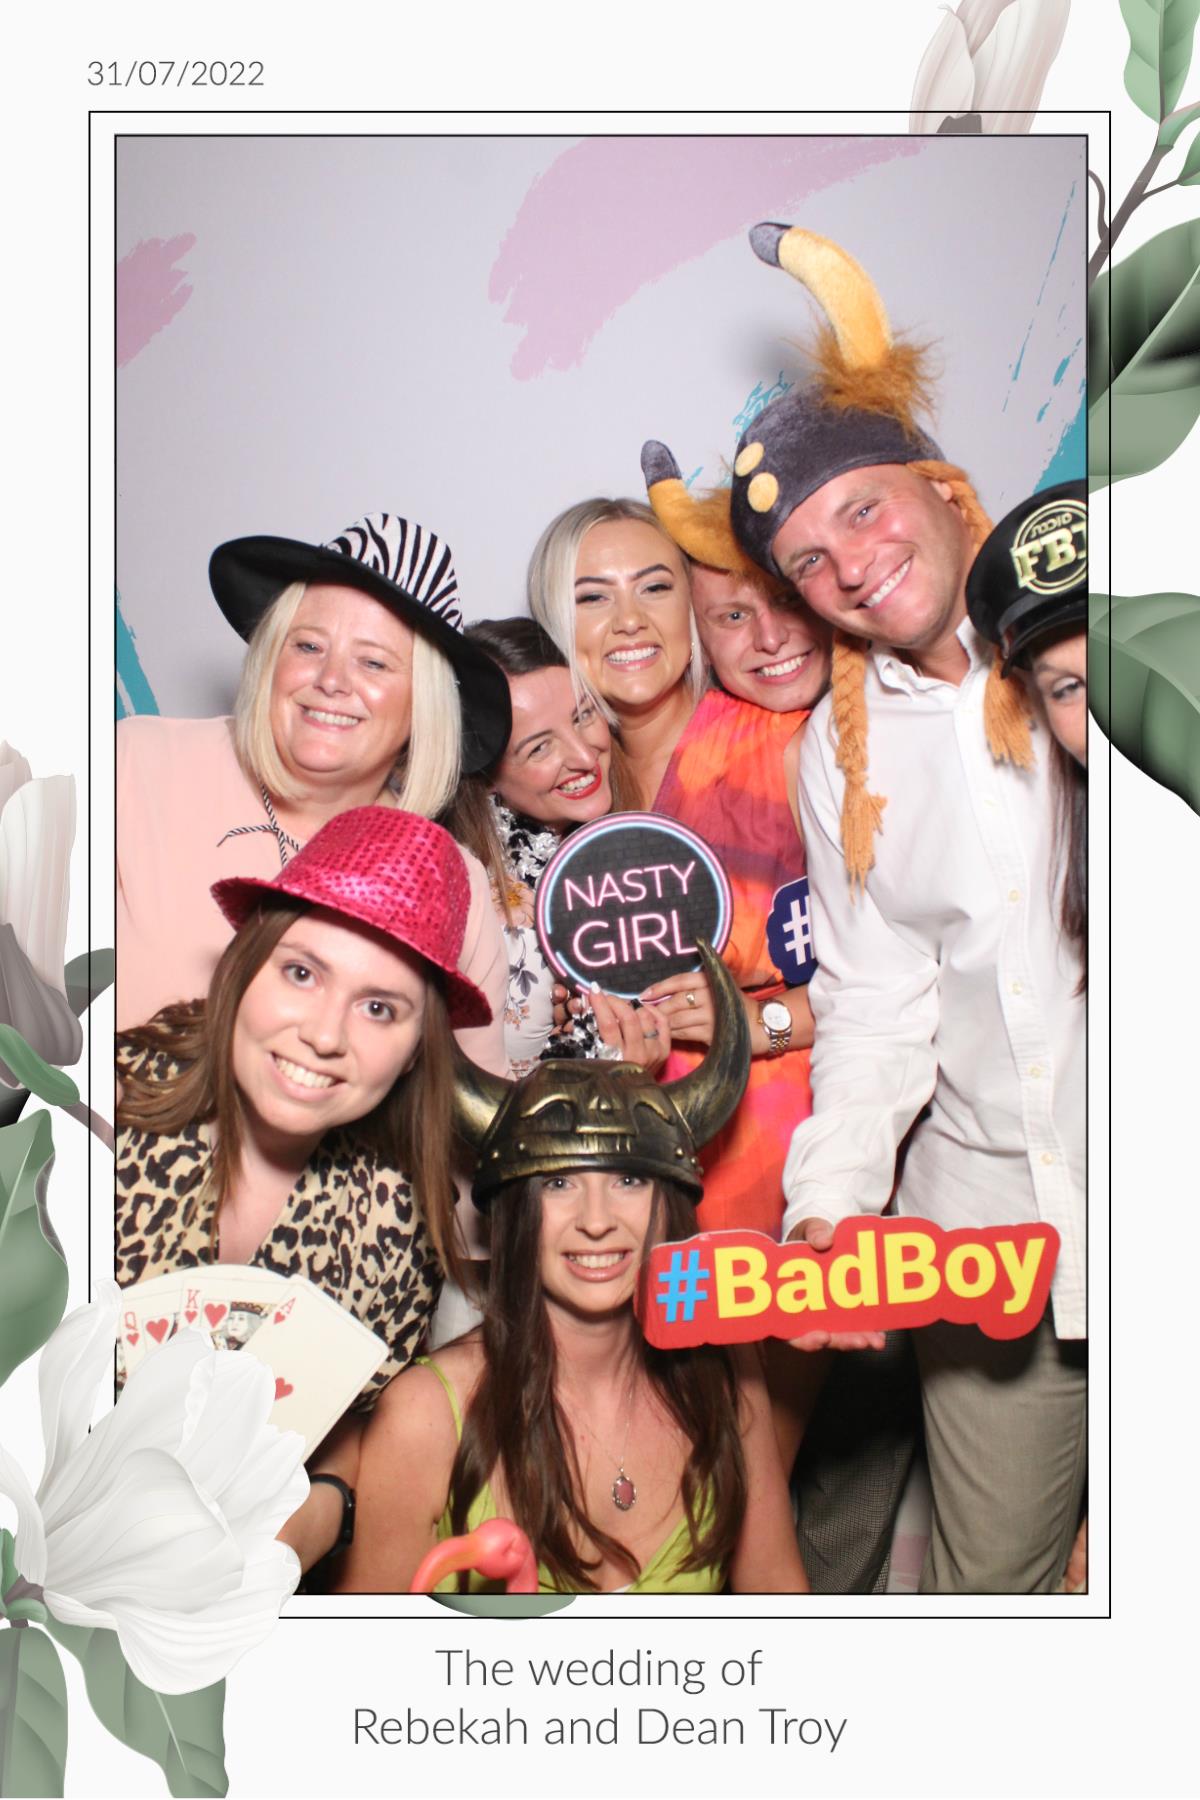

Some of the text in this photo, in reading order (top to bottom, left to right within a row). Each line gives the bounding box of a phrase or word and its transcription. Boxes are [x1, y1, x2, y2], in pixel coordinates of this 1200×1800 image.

[564, 860, 696, 911] NASTY
[572, 909, 699, 967] GIRL
[657, 1230, 1046, 1323] #BadBoy
[186, 1289, 200, 1309] K
[279, 1297, 296, 1315] A
[124, 1311, 137, 1331] Q
